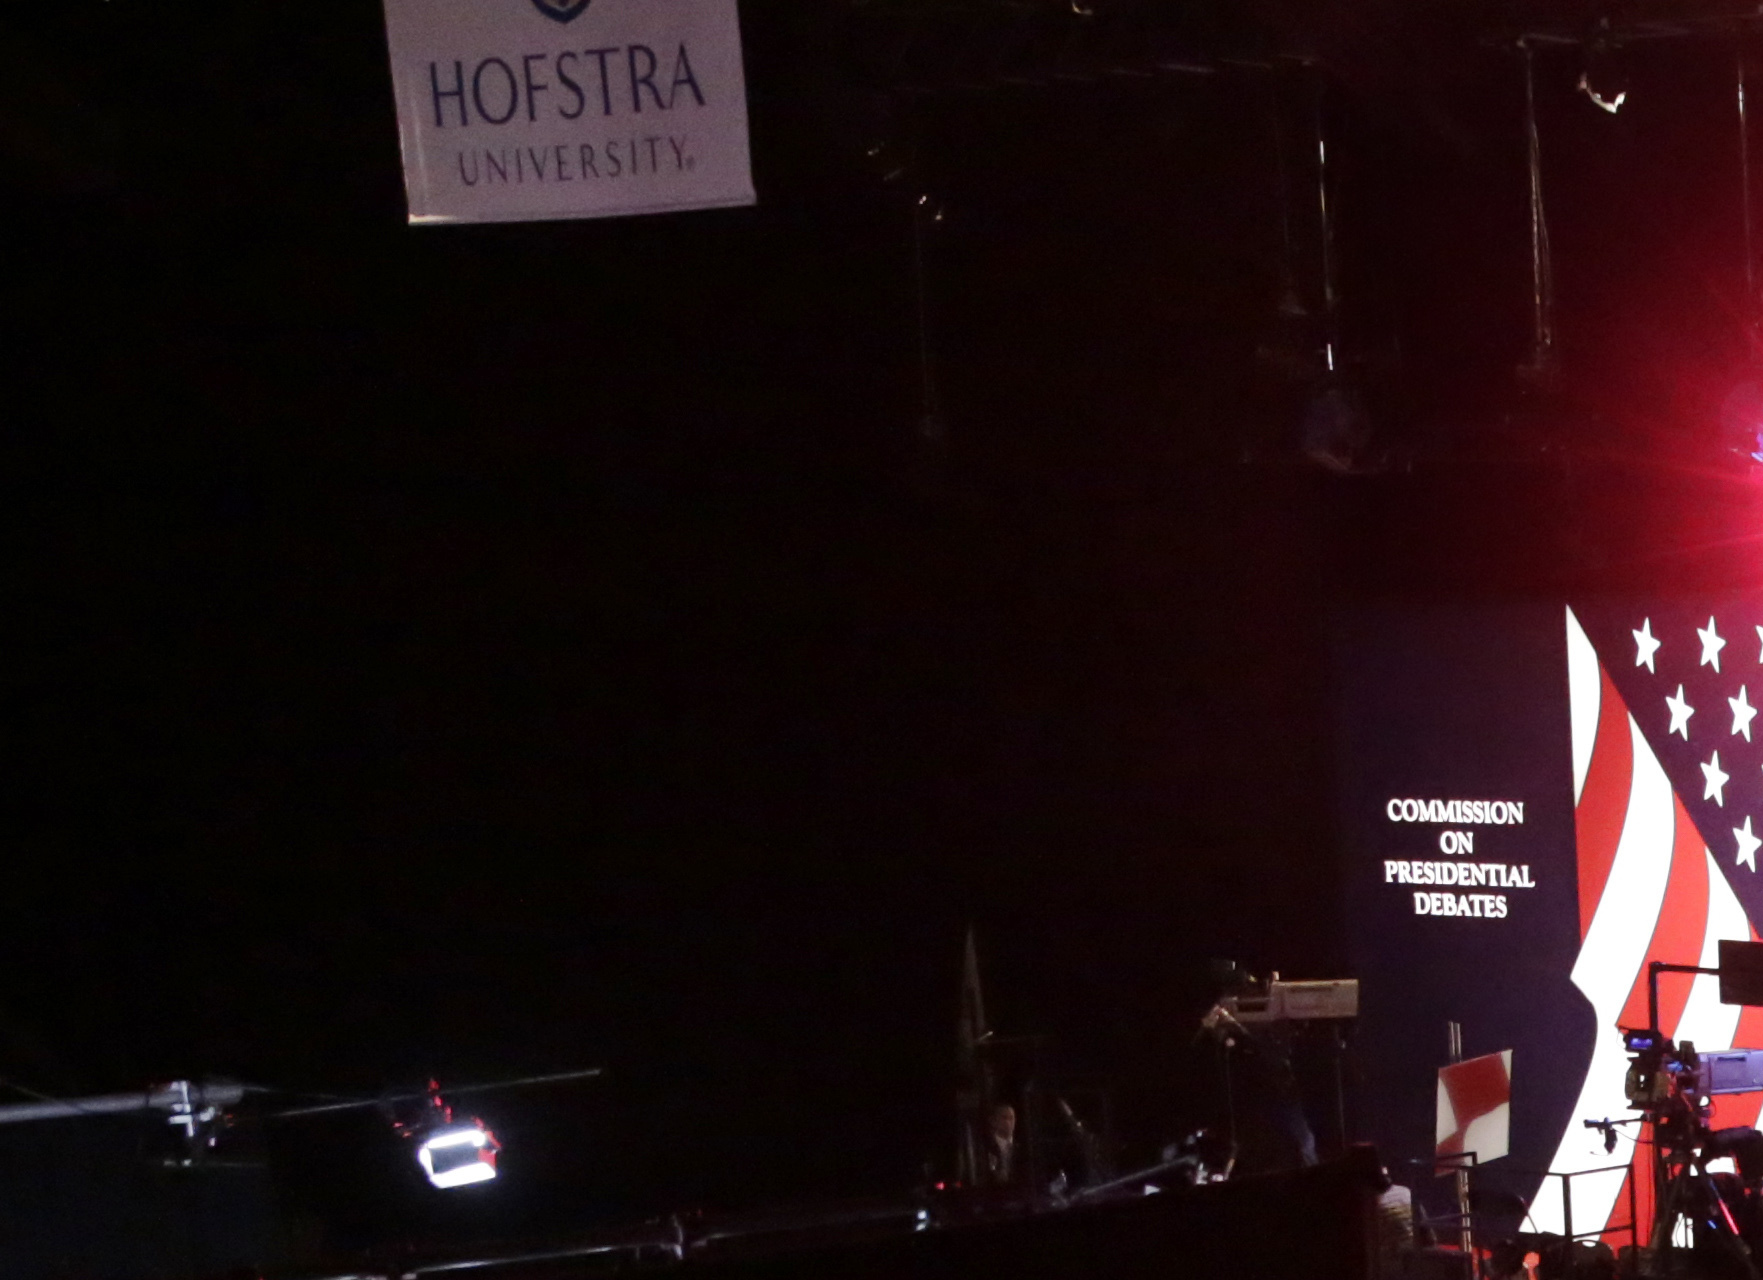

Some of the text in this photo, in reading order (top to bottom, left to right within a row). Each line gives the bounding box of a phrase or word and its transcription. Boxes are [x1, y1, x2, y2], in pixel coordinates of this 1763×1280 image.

[430, 41, 706, 127] HOFSTRA
[1387, 798, 1523, 824] COMMISSION
[1440, 831, 1473, 854] ON
[1384, 860, 1535, 888] PRESIDENTIAL
[1413, 892, 1507, 918] DEBATES
